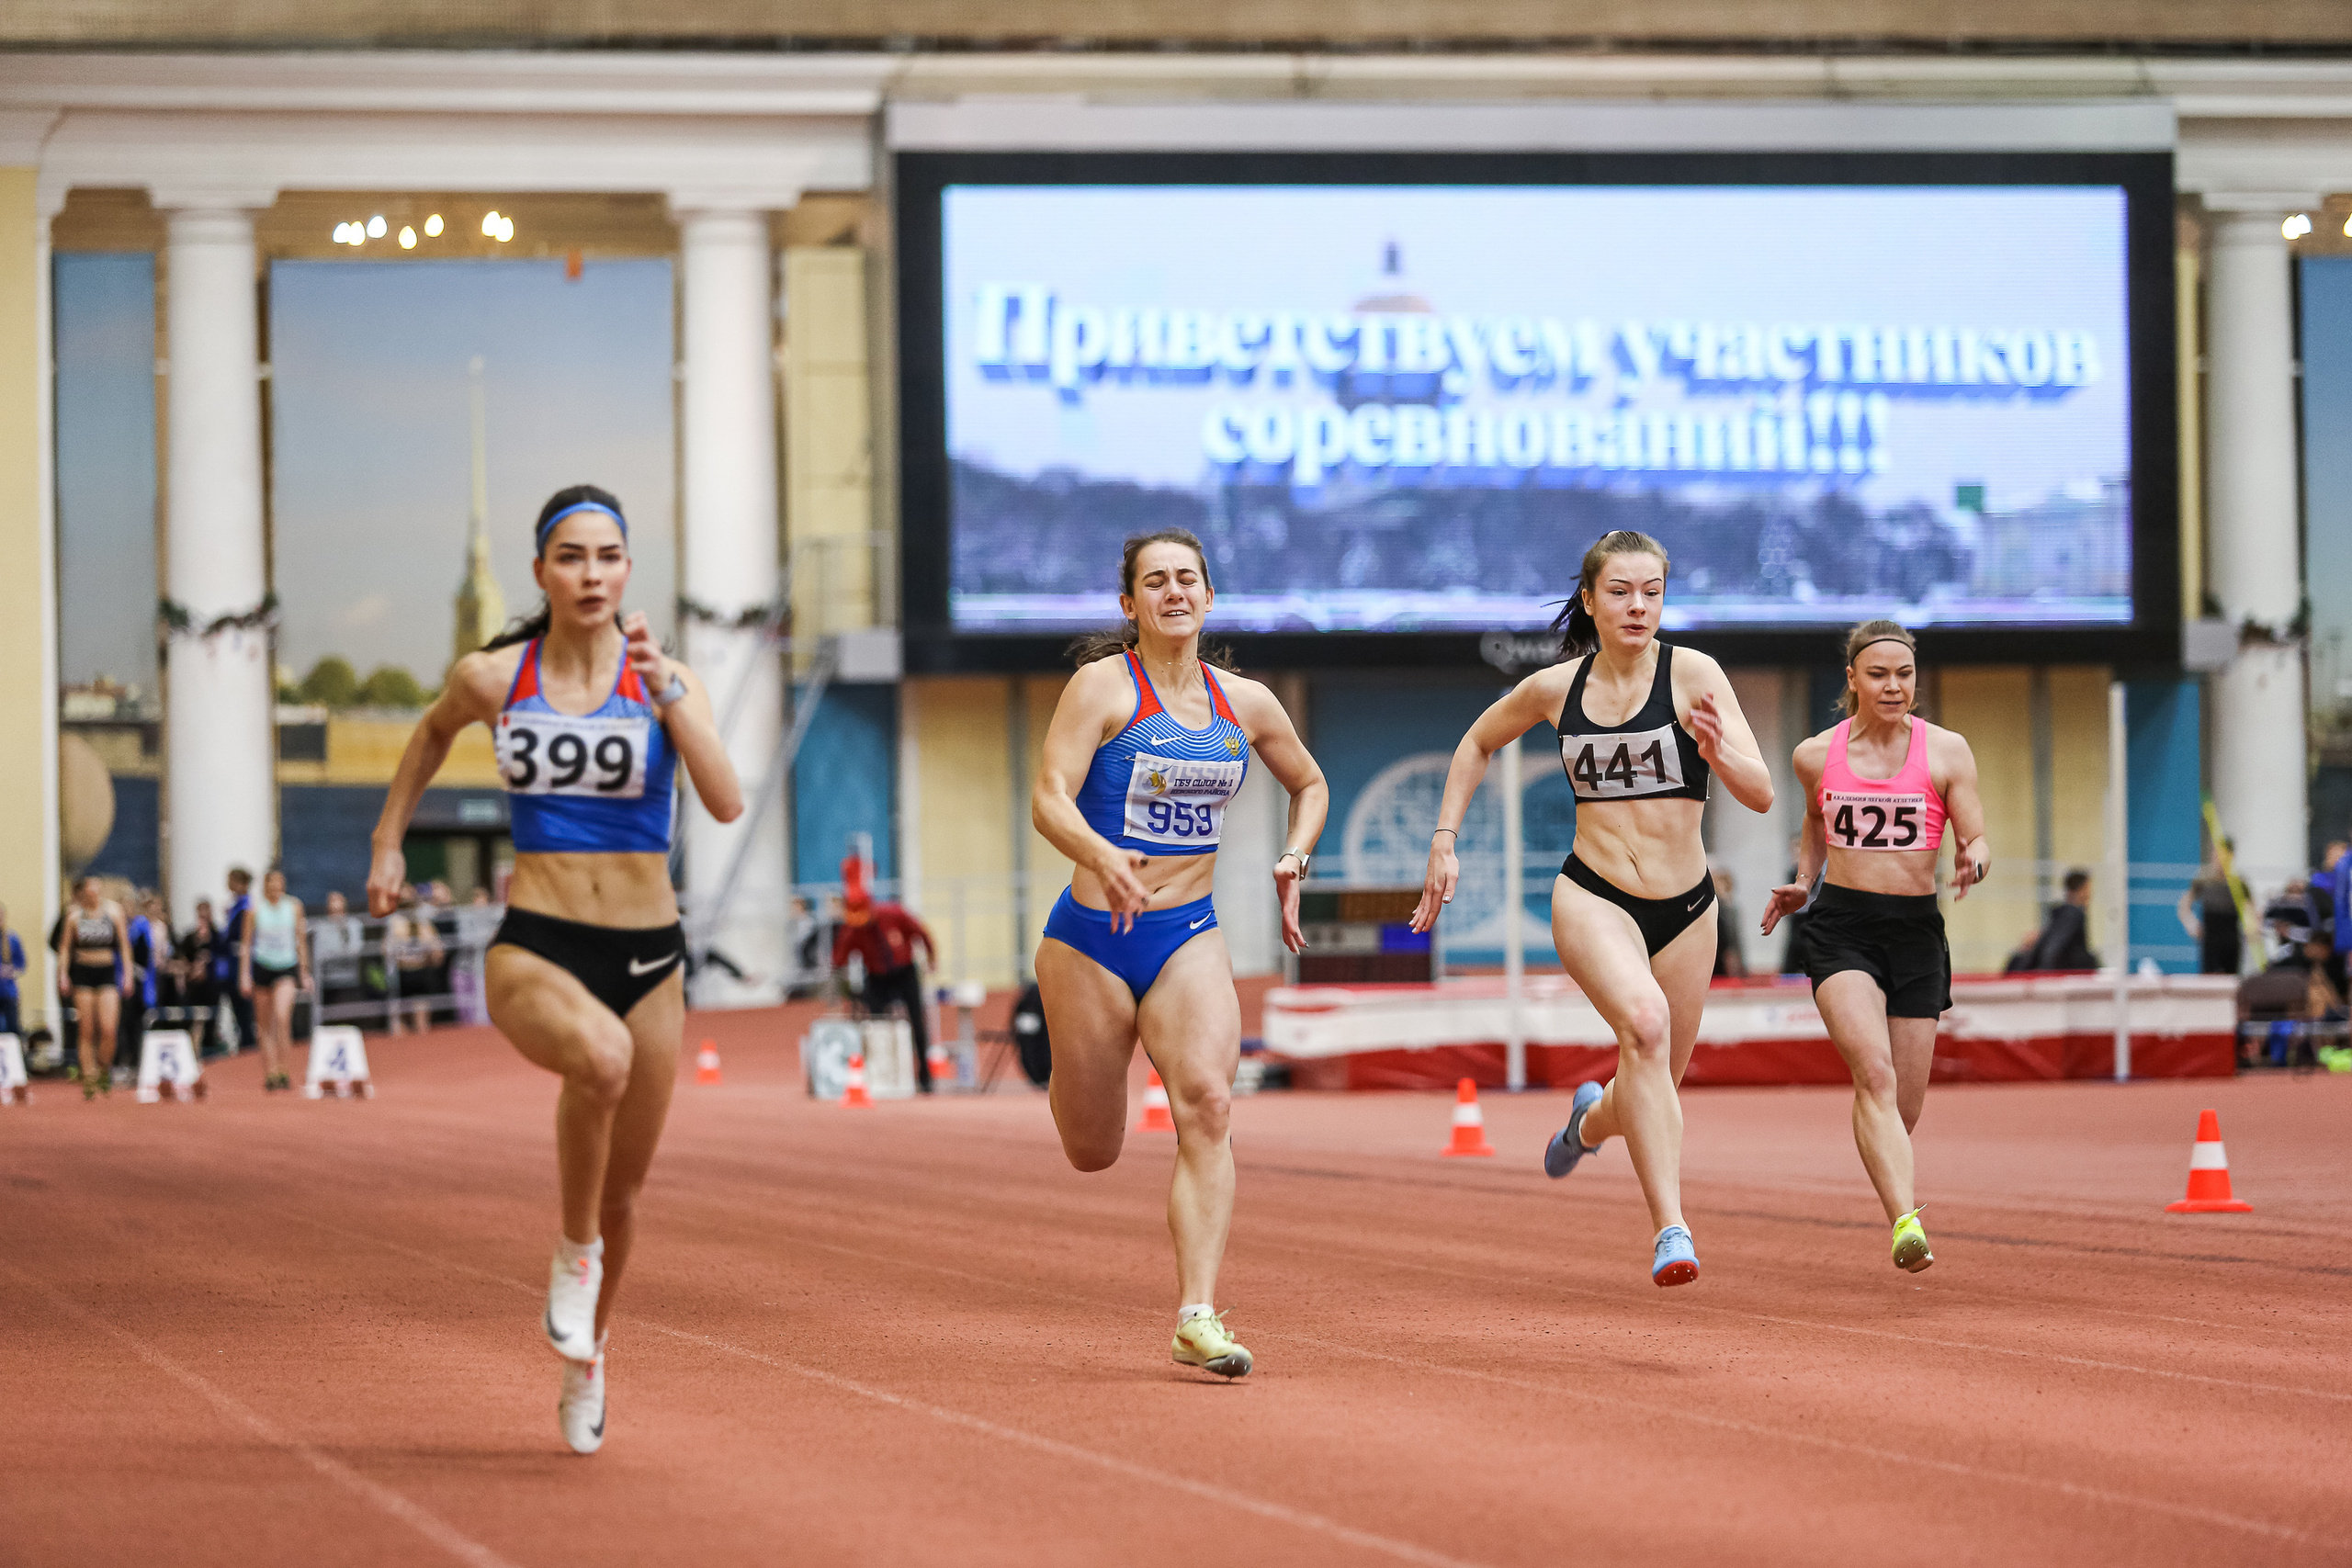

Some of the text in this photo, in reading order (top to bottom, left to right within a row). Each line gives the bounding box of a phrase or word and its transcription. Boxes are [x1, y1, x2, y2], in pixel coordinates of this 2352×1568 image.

[976, 281, 2102, 399] Приветствуем участников
[1200, 389, 1890, 487] соревнований!!!
[509, 727, 633, 793] 399
[1174, 779, 1192, 787] ГБУ
[1192, 779, 1217, 787] СШОР
[1228, 779, 1234, 787] 1
[1573, 739, 1667, 792] 441
[1148, 802, 1213, 836] 959
[1834, 805, 1918, 848] 425
